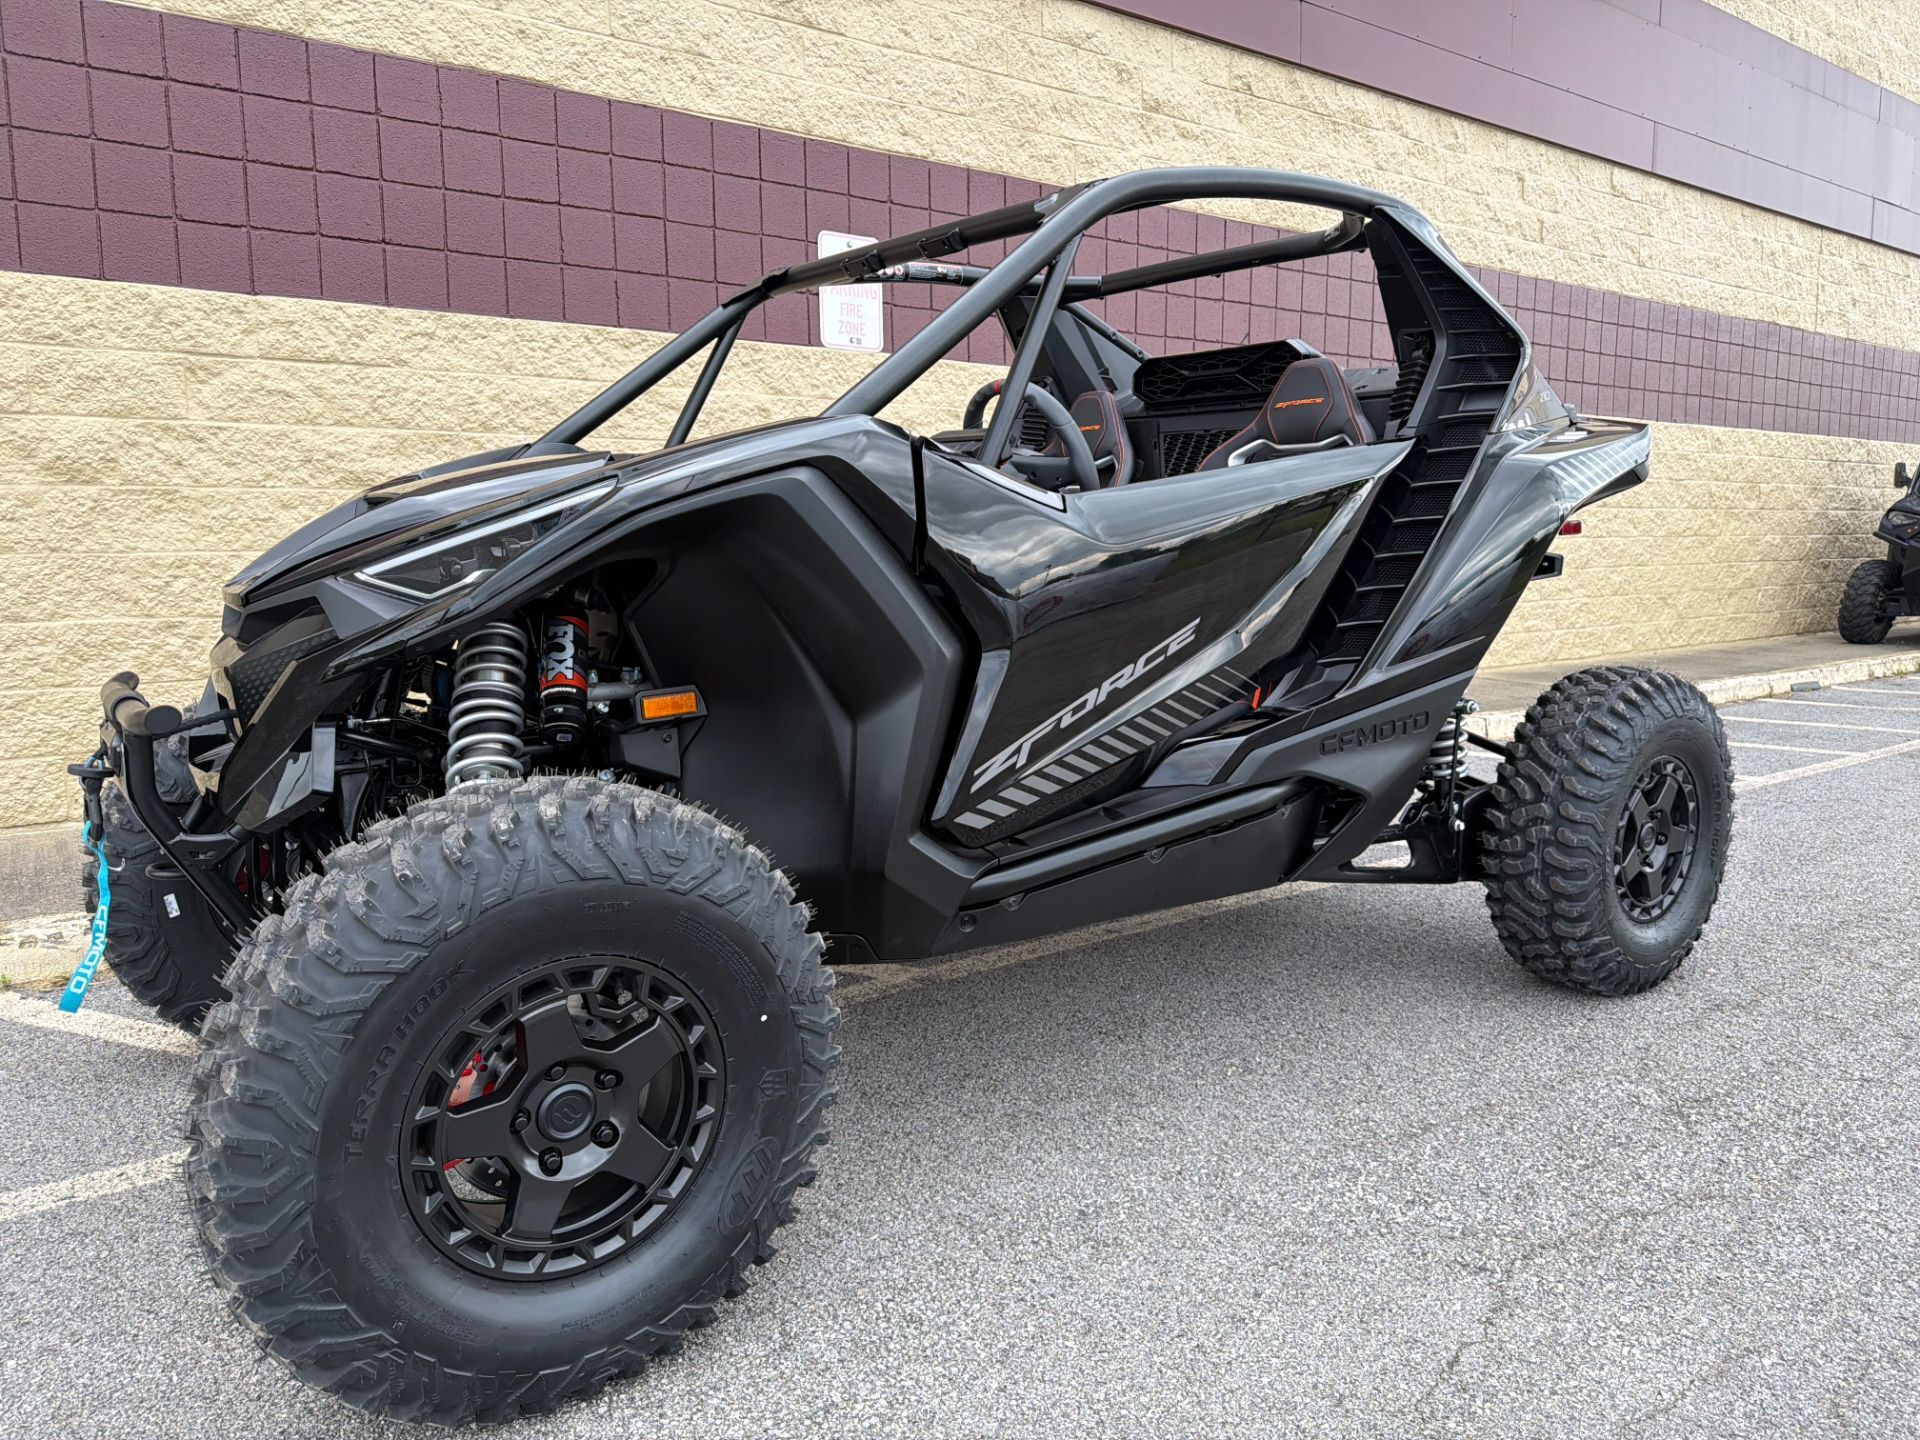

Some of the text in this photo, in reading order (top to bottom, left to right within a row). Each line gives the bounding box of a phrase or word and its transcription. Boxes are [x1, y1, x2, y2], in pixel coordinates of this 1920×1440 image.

[838, 319, 866, 337] ZONE
[840, 302, 863, 318] FIRE
[547, 623, 575, 681] FOX
[970, 616, 1201, 794] ZFORCE
[1318, 710, 1430, 758] CFMOTO
[69, 905, 107, 995] CFMOTO
[343, 960, 475, 1167] TERRA HOOK
